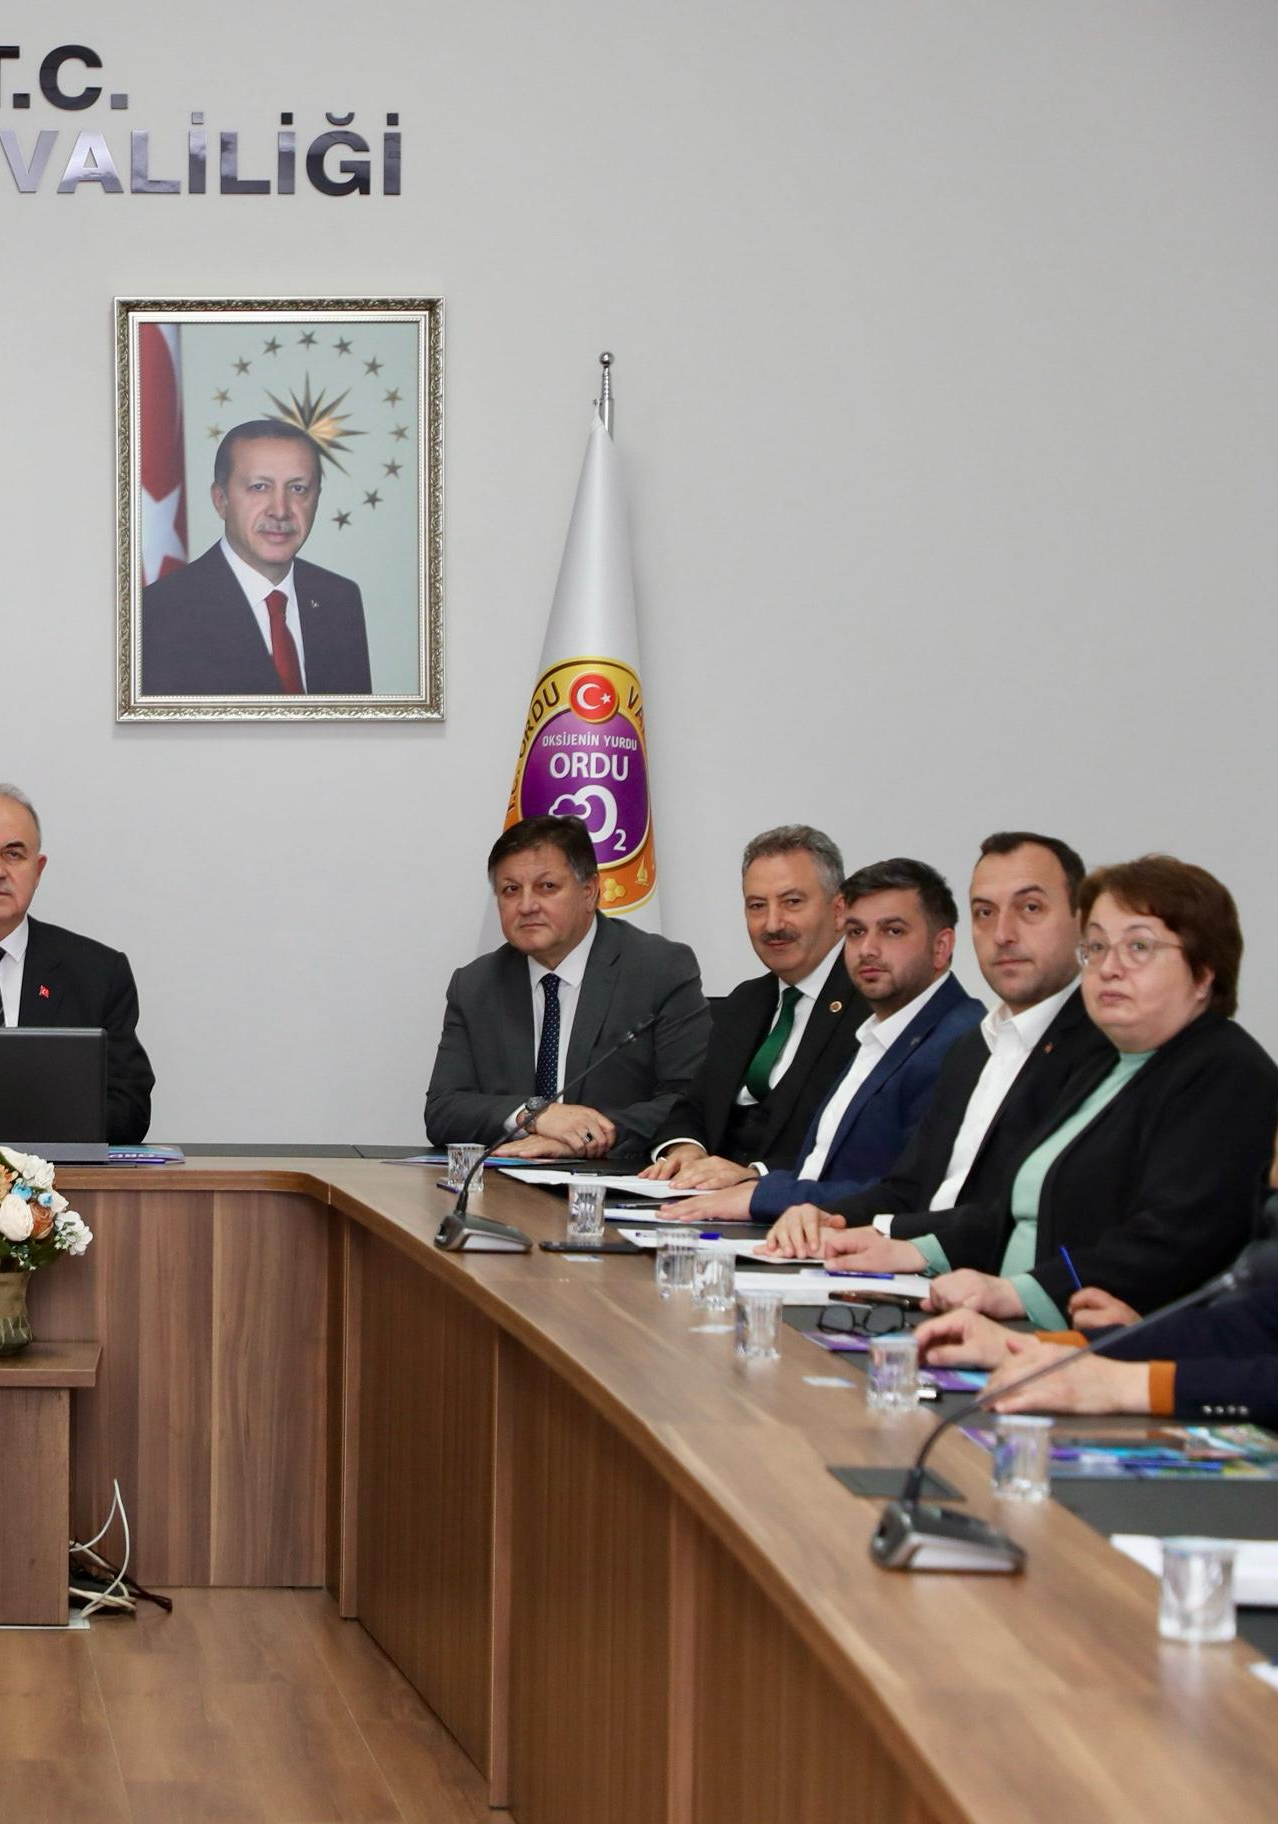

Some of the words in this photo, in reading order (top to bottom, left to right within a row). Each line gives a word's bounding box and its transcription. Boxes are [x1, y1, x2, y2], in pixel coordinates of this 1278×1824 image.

[542, 731, 599, 747] OKSİJENİN
[602, 735, 637, 751] YURDU
[549, 752, 629, 781] ORDU
